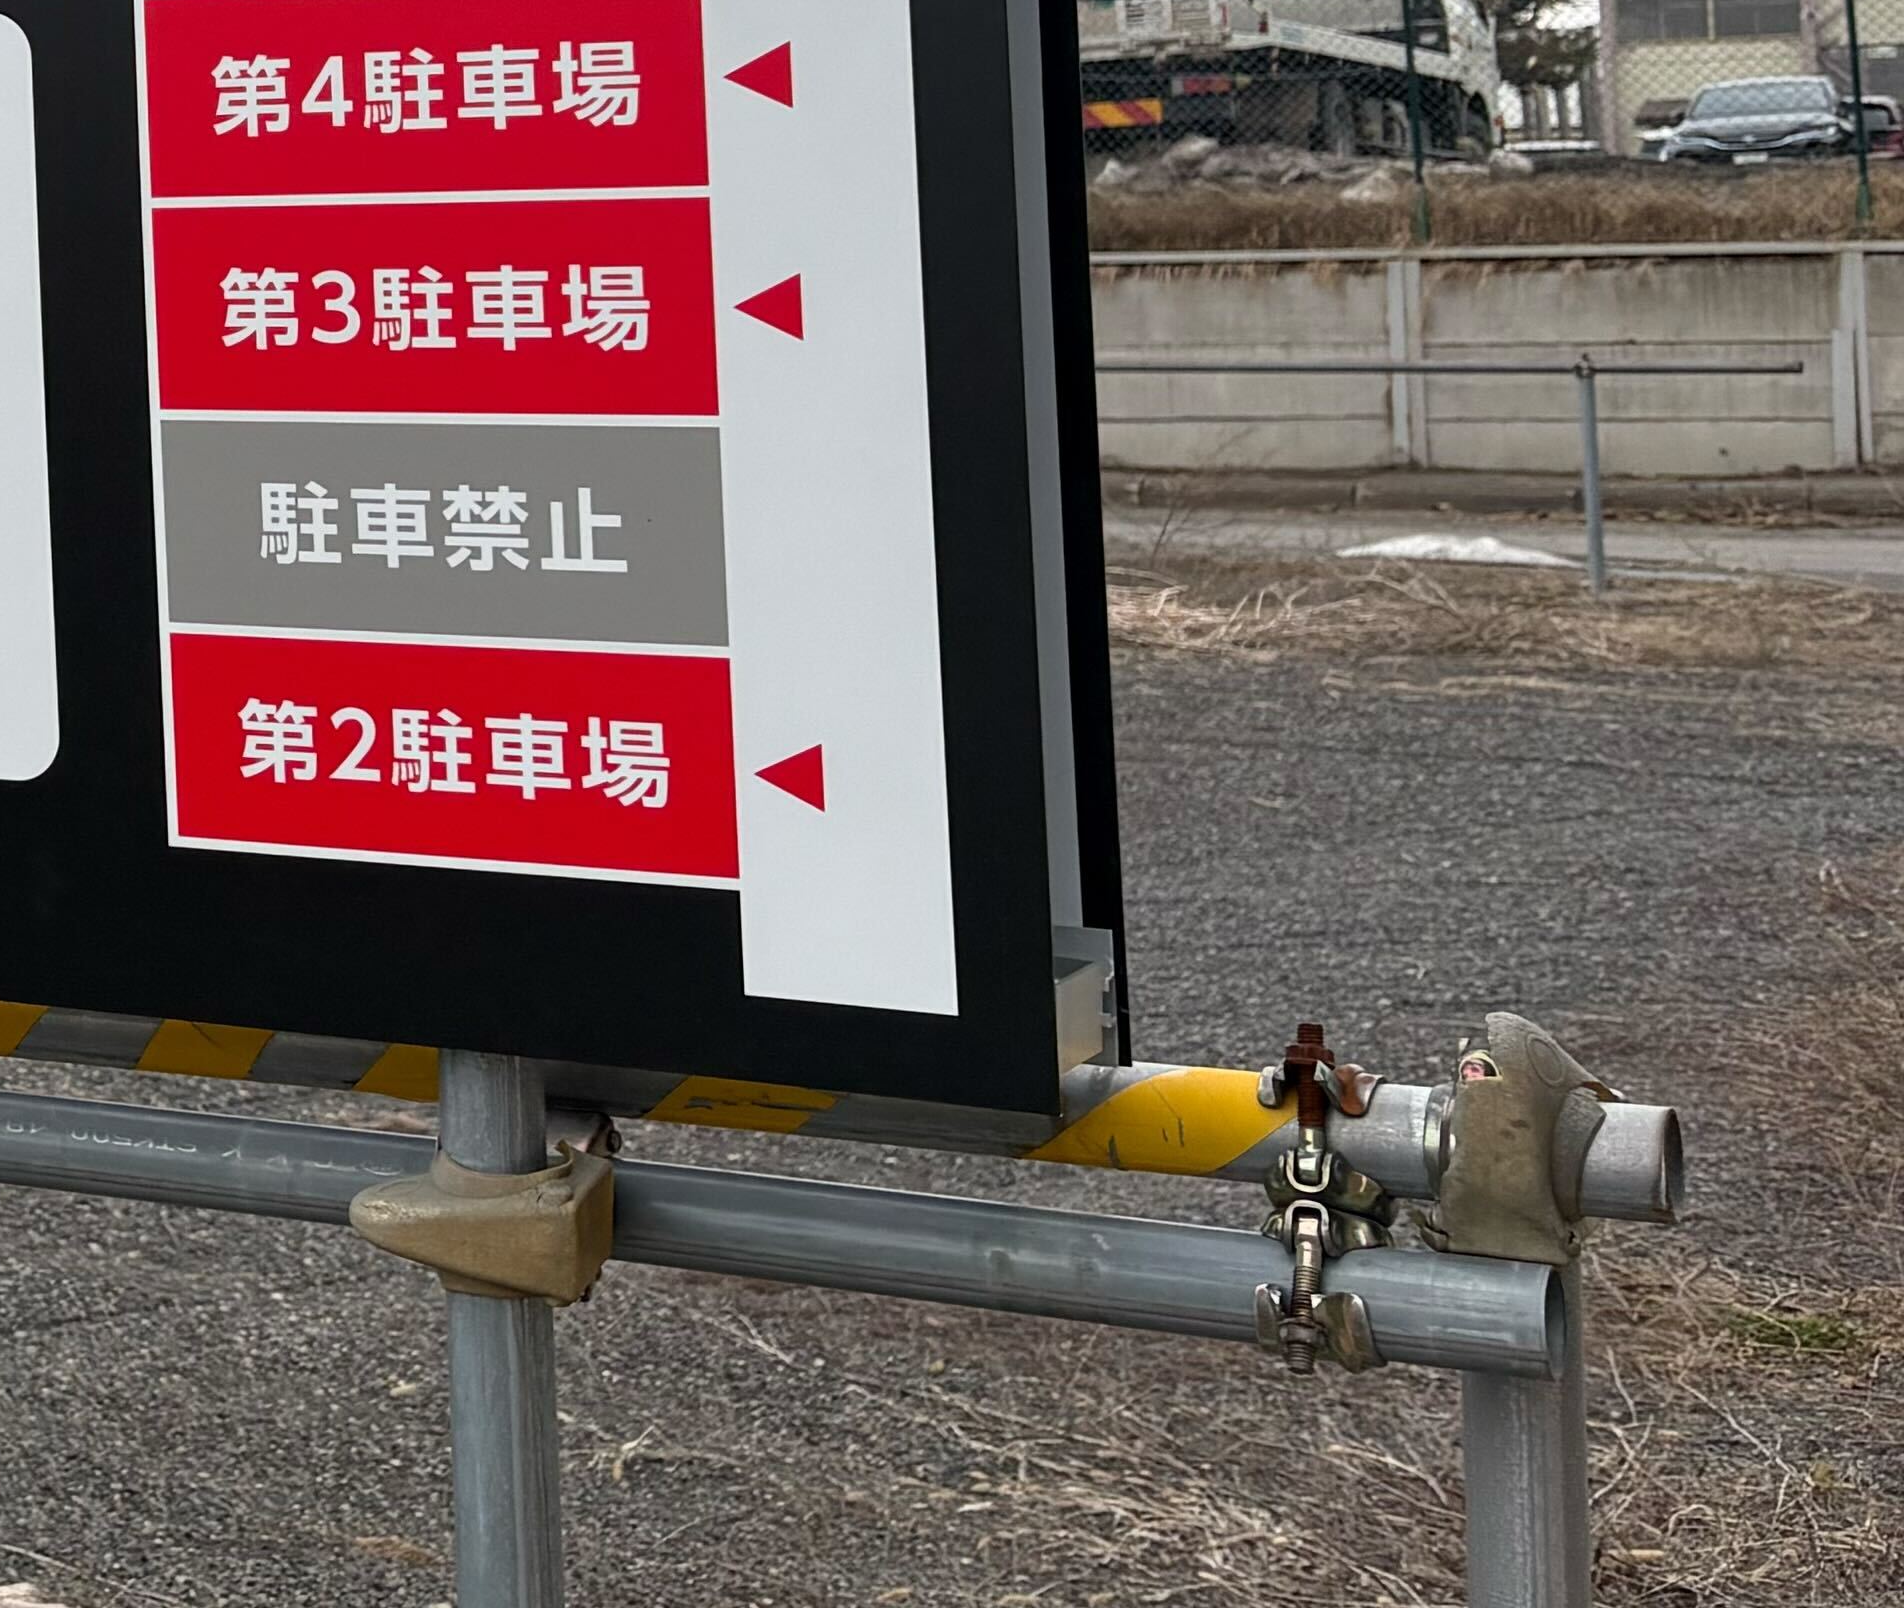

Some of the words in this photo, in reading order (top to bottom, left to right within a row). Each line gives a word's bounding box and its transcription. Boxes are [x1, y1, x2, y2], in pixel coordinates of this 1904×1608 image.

[210, 41, 641, 137] 第4駐車場
[220, 264, 650, 352] 第3駐車場
[260, 481, 628, 573] 駐車禁止
[237, 697, 670, 809] 第2駐車場
